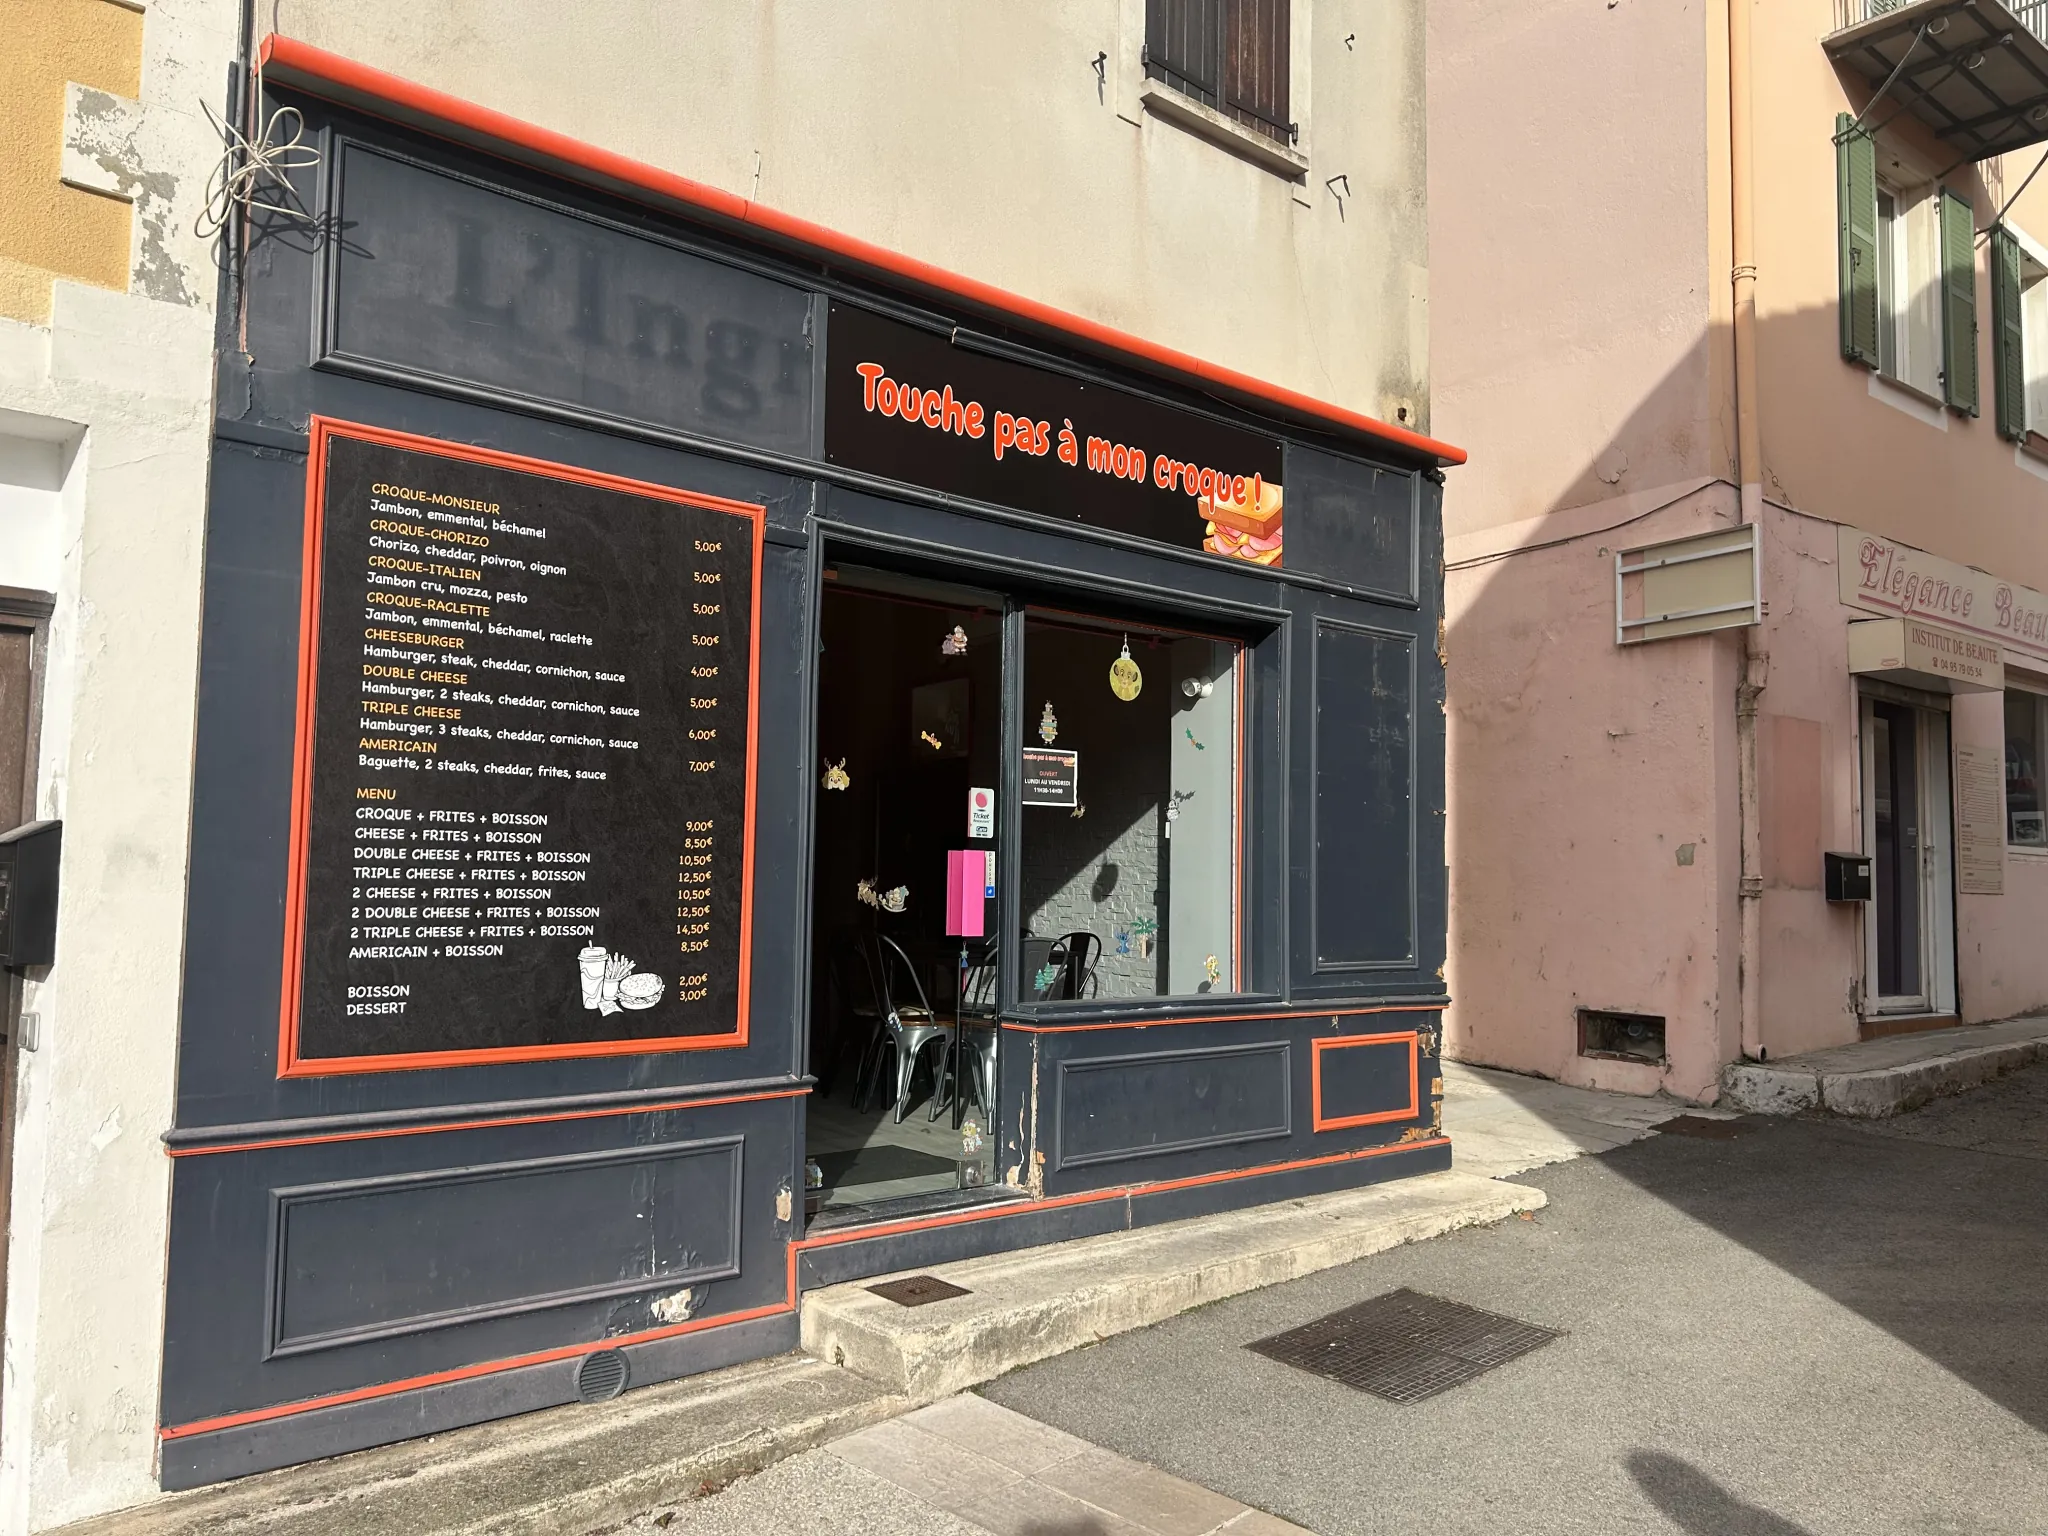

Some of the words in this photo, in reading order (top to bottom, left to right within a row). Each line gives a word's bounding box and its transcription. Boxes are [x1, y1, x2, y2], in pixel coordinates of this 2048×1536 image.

[855, 361, 986, 439] Touche
[993, 409, 1050, 460] pas
[1057, 418, 1078, 467] à
[1086, 435, 1148, 482] mon
[1153, 453, 1249, 514] croque
[1254, 471, 1264, 511] !
[371, 483, 500, 515] CROQUE-MONSIEUR
[370, 498, 422, 519] Jambon,
[426, 511, 487, 530] emmental,
[492, 519, 545, 539] béchamel
[370, 519, 489, 547] CROQUE-CHORIZO
[694, 540, 721, 552] 5,00€
[369, 535, 420, 554] Chorizo,
[424, 544, 476, 563] cheddar,
[480, 554, 526, 570] poivron,
[529, 560, 566, 575] oignon
[368, 555, 481, 581] CROQUE-ITALIEN
[694, 571, 721, 584] 5,00€
[366, 571, 416, 588] Jambon
[420, 581, 445, 594] cru,
[449, 585, 491, 600] mozza,
[496, 591, 527, 603] pesto
[366, 591, 490, 617] CROQUE-RACLETTE
[692, 603, 720, 615] 5,00€
[1994, 583, 2048, 641] Beau
[365, 607, 417, 626] Jambon,
[422, 617, 483, 634] emmental,
[488, 622, 545, 641] béchamel,
[549, 632, 592, 645] raclette
[364, 627, 464, 649] CHEESEBURGER
[692, 634, 719, 646] 5,00€
[1912, 628, 1951, 652] INSTITUT
[1953, 639, 1964, 656] DE
[1966, 642, 1998, 664] BEAUTE
[363, 643, 436, 664] Hamburger,
[440, 652, 477, 668] steak,
[481, 657, 531, 674] cheddar,
[535, 665, 591, 680] cornichon,
[594, 671, 625, 682] sauce
[1941, 659, 1948, 670] 04
[1959, 664, 1966, 674] 79
[1967, 666, 1974, 676] 05
[363, 664, 415, 679] DOUBLE
[420, 670, 467, 684] CHEESE
[690, 666, 718, 677] 4,00€
[361, 680, 434, 700] Hamburger,
[439, 688, 447, 699] 2
[452, 689, 493, 705] steaks,
[498, 693, 546, 709] cheddar,
[551, 700, 606, 715] cornichon,
[609, 706, 639, 716] sauce
[690, 697, 717, 709] 5,00€
[361, 700, 408, 715] TRIPLE
[413, 705, 461, 719] CHEESE
[360, 717, 433, 736] Hamburger,
[438, 723, 446, 734] 3
[450, 724, 492, 739] steaks,
[496, 728, 545, 743] cheddar,
[549, 734, 604, 748] cornichon,
[608, 739, 638, 749] sauce
[688, 729, 716, 740] 6,00€
[358, 737, 436, 753] AMERICAIN
[358, 754, 419, 770] Baguette,
[424, 758, 432, 769] 2
[437, 759, 479, 774] steaks,
[483, 762, 533, 777] cheddar,
[538, 764, 571, 779] frites,
[575, 770, 606, 780] sauce
[688, 760, 715, 772] 7,00€
[356, 787, 396, 800] MENU
[355, 807, 412, 821] CROQUE
[416, 812, 424, 821] +
[429, 810, 475, 823] FRITES
[479, 815, 487, 823] +
[492, 812, 547, 825] BOISSON
[685, 819, 713, 832] 9,00€
[354, 827, 405, 839] CHEESE
[410, 831, 417, 840] +
[422, 829, 468, 841] FRITES
[473, 833, 480, 842] +
[485, 831, 541, 843] BOISSON
[684, 836, 712, 849] 8,50€
[353, 846, 407, 859] DOUBLE
[411, 848, 460, 860] CHEESE
[464, 852, 472, 861] +
[476, 849, 520, 862] FRITES
[525, 854, 532, 862] +
[537, 851, 590, 863] BOISSON
[679, 853, 712, 866] 10,50€
[352, 866, 401, 879] TRIPLE
[405, 867, 454, 879] CHEESE
[459, 871, 466, 880] +
[471, 868, 515, 880] FRITES
[519, 872, 527, 880] +
[531, 869, 585, 881] BOISSON
[678, 870, 711, 883] 12,50€
[352, 887, 360, 898] 2
[365, 887, 415, 898] CHEESE
[420, 890, 428, 898] +
[433, 887, 479, 899] FRITES
[483, 890, 491, 899] +
[495, 888, 551, 899] BOISSON
[678, 887, 711, 900] 10,50€
[351, 906, 359, 918] 2
[364, 906, 417, 918] DOUBLE
[422, 906, 470, 918] CHEESE
[474, 909, 482, 918] +
[486, 906, 530, 918] FRITES
[534, 909, 542, 917] +
[546, 906, 599, 917] BOISSON
[677, 904, 710, 918] 12,50€
[350, 926, 358, 938] 2
[362, 926, 410, 938] TRIPLE
[415, 926, 463, 938] CHEESE
[467, 928, 475, 937] +
[480, 925, 524, 937] FRITES
[528, 928, 535, 936] +
[540, 925, 593, 936] BOISSON
[676, 921, 709, 935] 14,50€
[348, 945, 427, 958] AMERICAIN
[432, 948, 440, 957] +
[445, 944, 503, 956] BOISSON
[680, 939, 709, 952] 8,50€
[679, 973, 707, 987] 2,00€
[347, 984, 410, 998] BOISSON
[679, 988, 707, 1001] 3,00€
[346, 1001, 407, 1015] DESSERT
